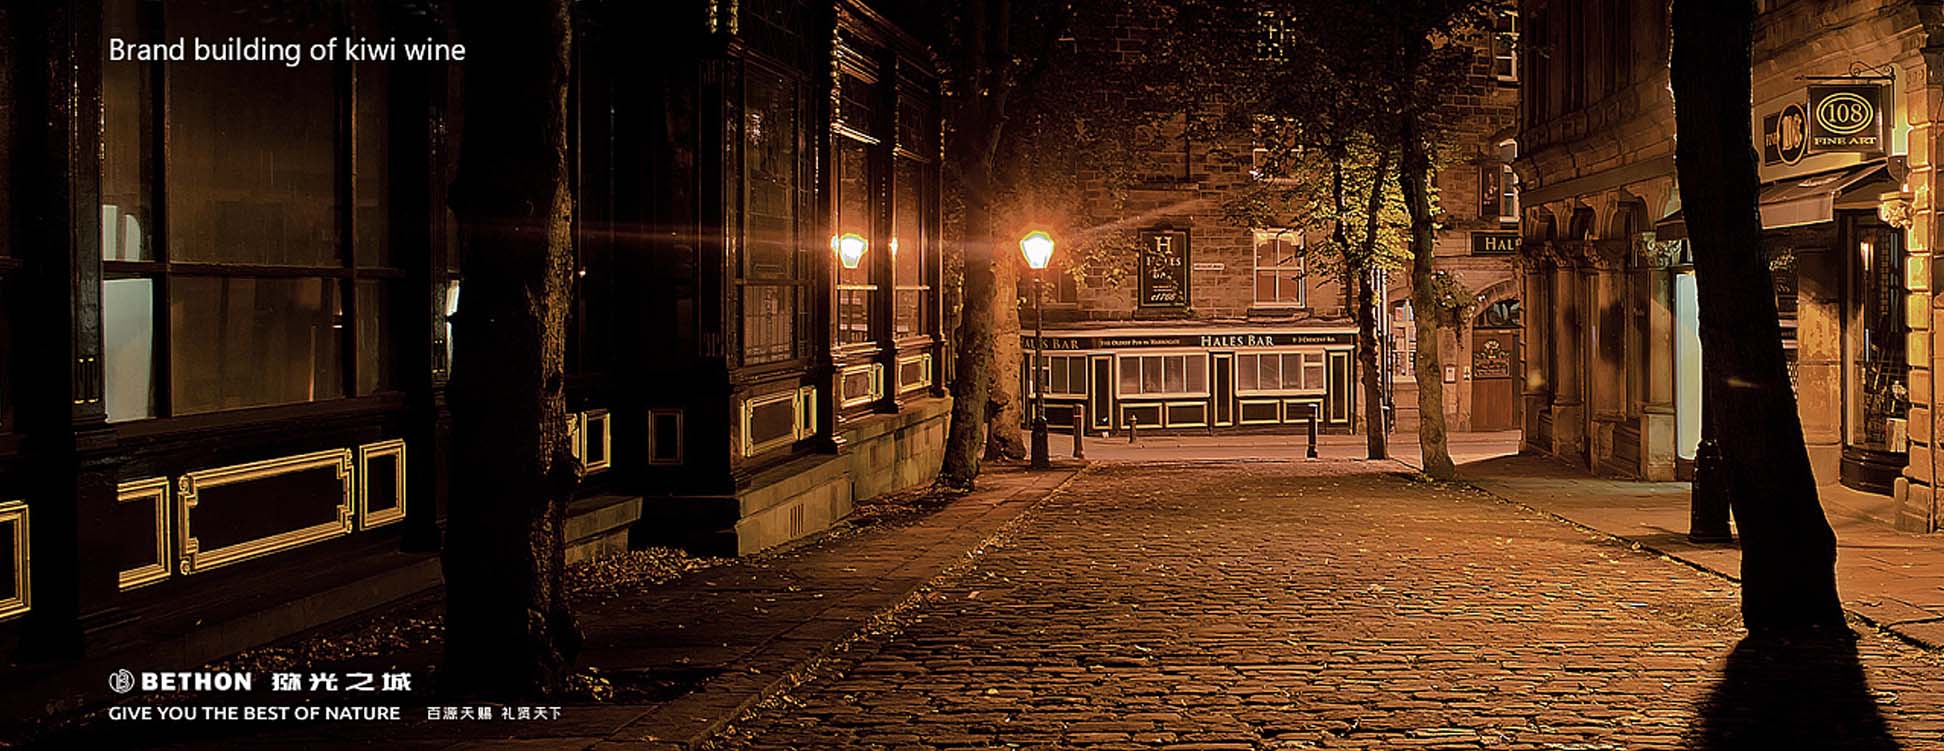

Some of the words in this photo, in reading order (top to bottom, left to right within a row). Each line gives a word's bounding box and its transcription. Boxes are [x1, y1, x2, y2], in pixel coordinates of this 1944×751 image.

[1827, 103, 1864, 123] 108
[1813, 136, 1847, 146] FINE
[1848, 136, 1877, 145] ART
[1154, 236, 1173, 255] H
[1052, 338, 1080, 350] BAR
[1200, 335, 1244, 347] HALES
[1247, 334, 1276, 346] BAR
